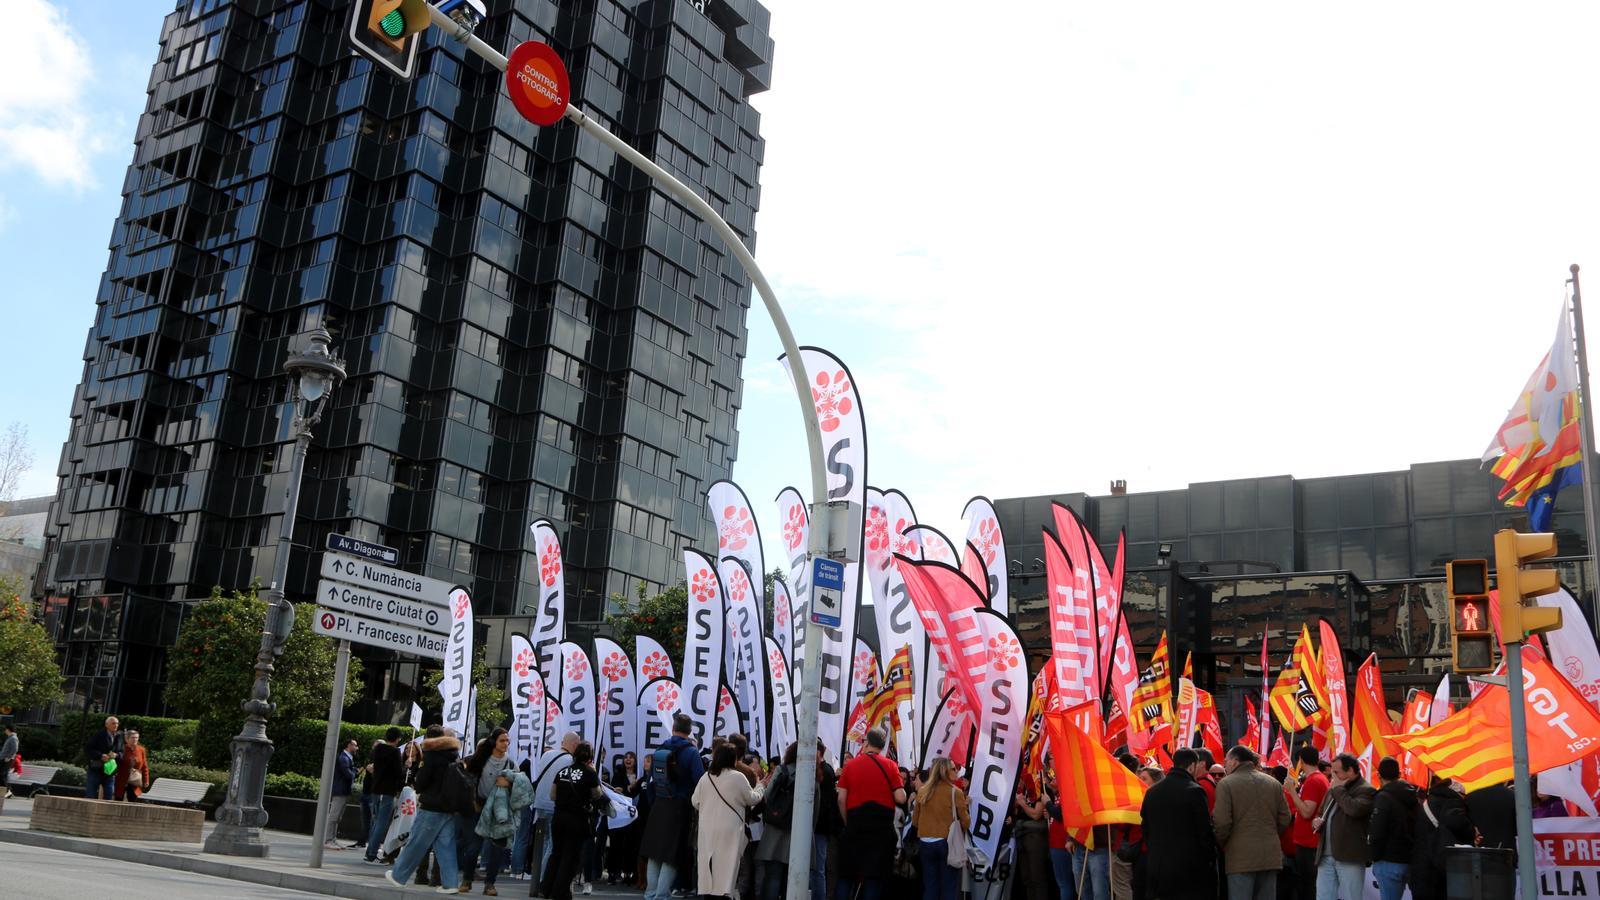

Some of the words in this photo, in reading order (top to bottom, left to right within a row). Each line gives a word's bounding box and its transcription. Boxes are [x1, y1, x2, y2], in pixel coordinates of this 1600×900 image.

[524, 64, 558, 92] CONTROL
[338, 538, 352, 550] Av.
[353, 541, 389, 557] Diagona
[345, 561, 358, 577] C.
[362, 565, 422, 593] Numància
[341, 588, 383, 611] Centre
[387, 599, 422, 621] Ciutat
[336, 616, 352, 633] Pl.
[356, 621, 413, 646] Francesc
[972, 679, 1012, 841] SECB
